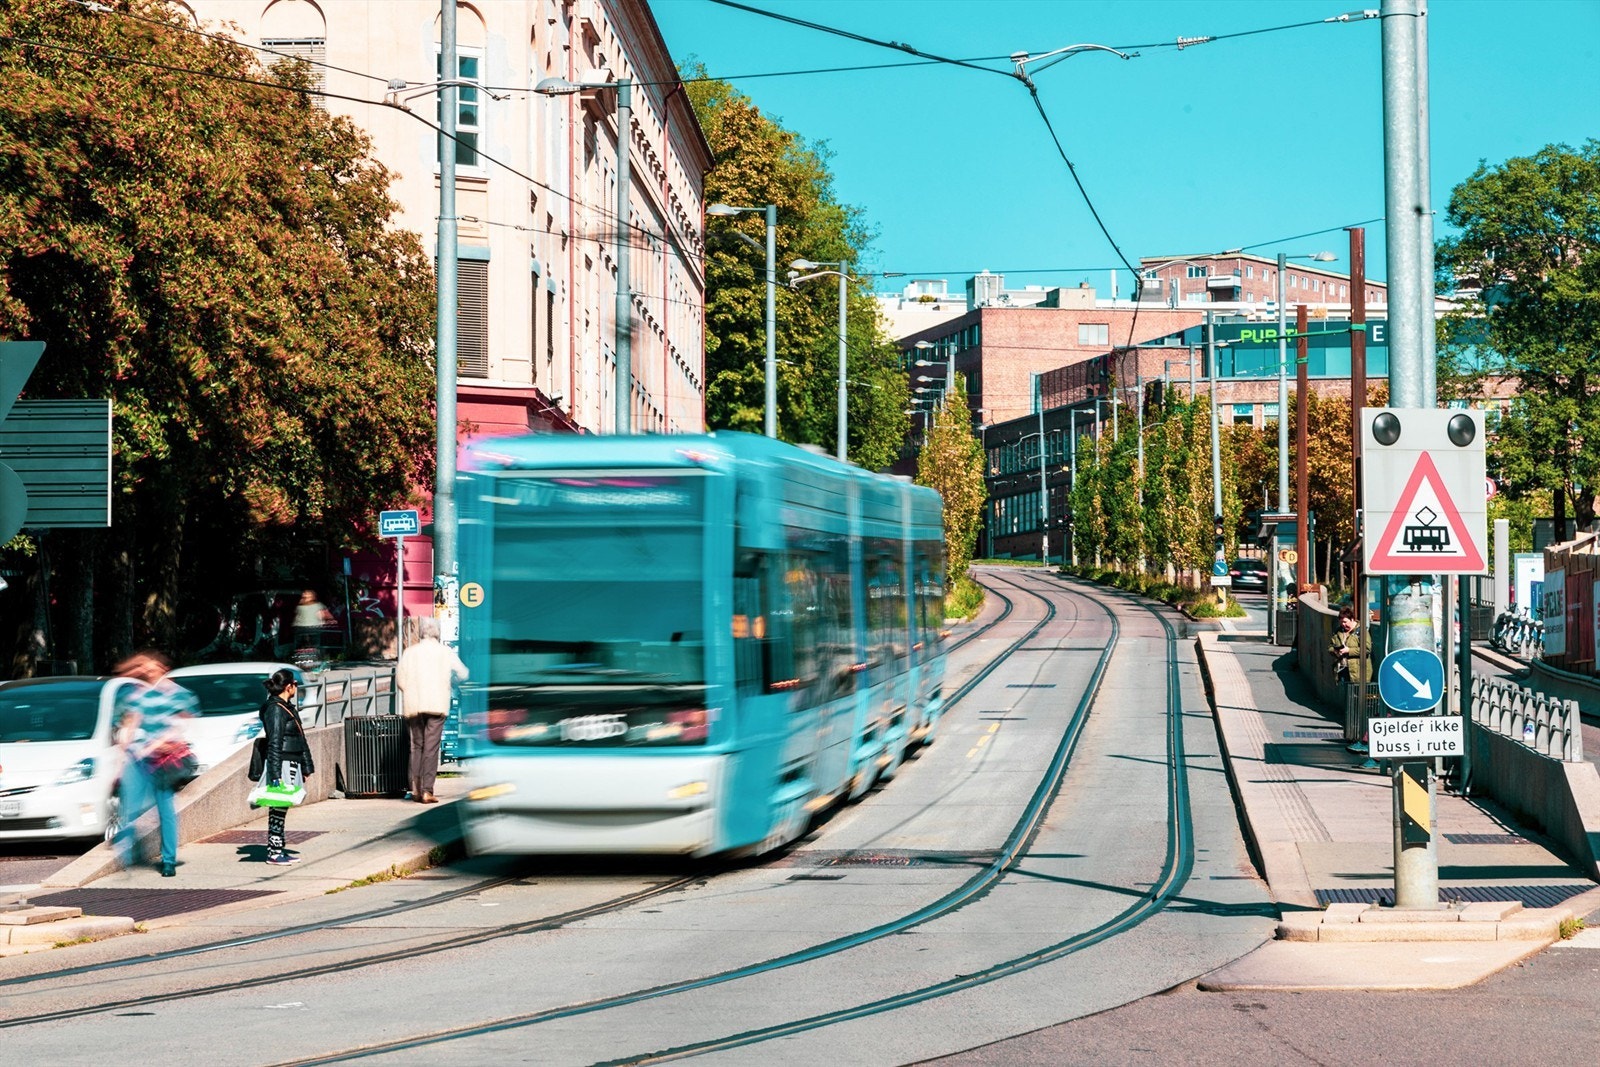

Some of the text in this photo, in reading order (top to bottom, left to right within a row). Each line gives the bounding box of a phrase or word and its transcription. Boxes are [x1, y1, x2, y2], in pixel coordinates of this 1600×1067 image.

[1372, 325, 1385, 342] E
[467, 587, 478, 602] E
[1372, 720, 1459, 736] Gjelder ikke
[1376, 739, 1456, 752] buss i rute
